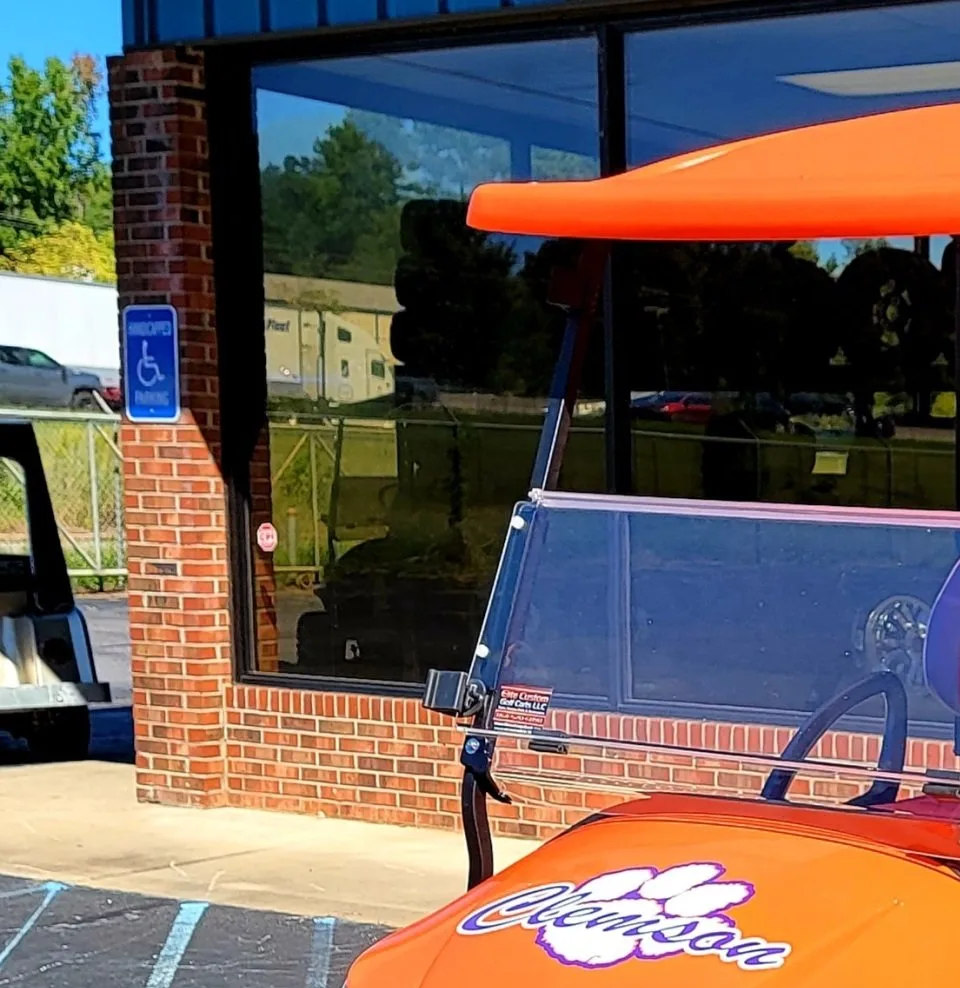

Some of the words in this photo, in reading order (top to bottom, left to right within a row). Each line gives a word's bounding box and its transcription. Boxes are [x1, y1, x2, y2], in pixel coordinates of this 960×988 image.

[519, 692, 549, 702] Custom
[500, 698, 514, 706] Golf
[514, 700, 531, 708] Carts
[532, 702, 547, 710] LLC
[457, 883, 791, 969] Clemson
